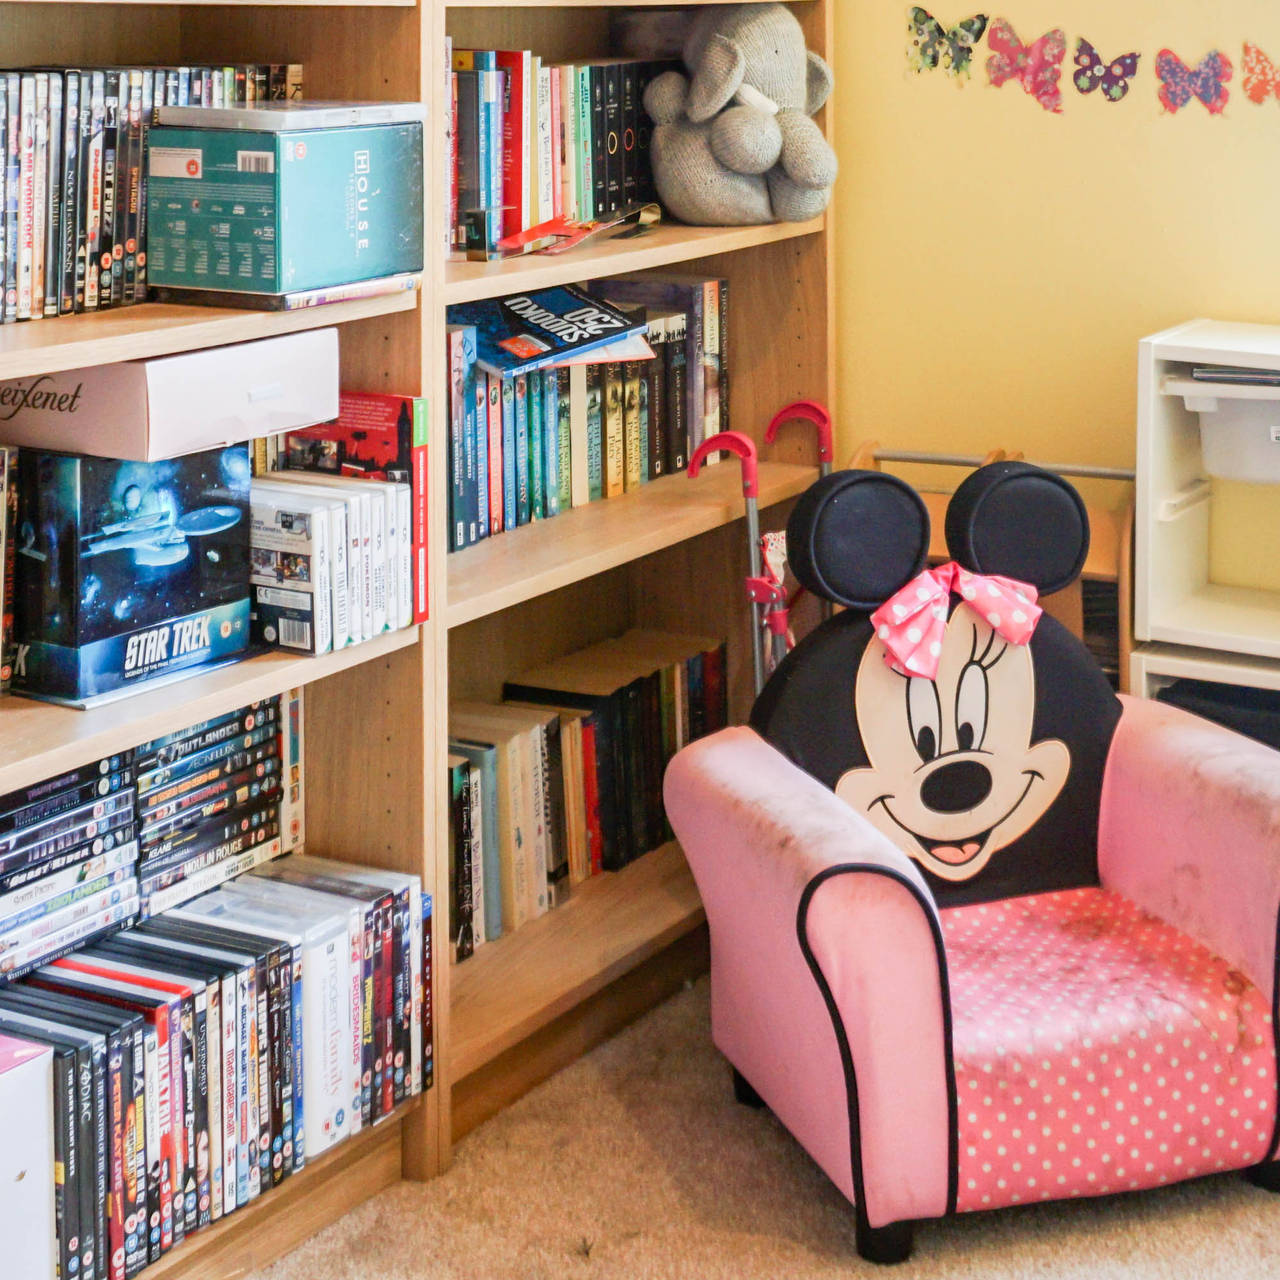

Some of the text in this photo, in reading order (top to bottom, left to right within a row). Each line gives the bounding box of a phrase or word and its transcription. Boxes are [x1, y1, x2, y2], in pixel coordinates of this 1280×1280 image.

[23, 176, 33, 250] WOODCOCK
[356, 151, 370, 250] HOUSE
[504, 296, 590, 344] SUDOKU
[563, 307, 624, 336] 250
[594, 420, 602, 441] THE
[608, 435, 616, 461] PREY
[614, 417, 622, 438] THE
[124, 615, 211, 671] STAR TREK
[178, 721, 240, 756] OUTLANDER
[183, 838, 243, 877] MOULIN ROUGE
[240, 1003, 248, 1047] MICHAEL
[352, 974, 360, 1065] BRIDESMAIDS
[67, 1067, 75, 1086] THE
[199, 1023, 207, 1096] UNDERWORLD
[67, 1087, 75, 1113] DARK
[80, 1060, 92, 1123] ZODIAC
[158, 1041, 170, 1138] VALKYRIE
[113, 1071, 122, 1191] PETER KAY LIVE
